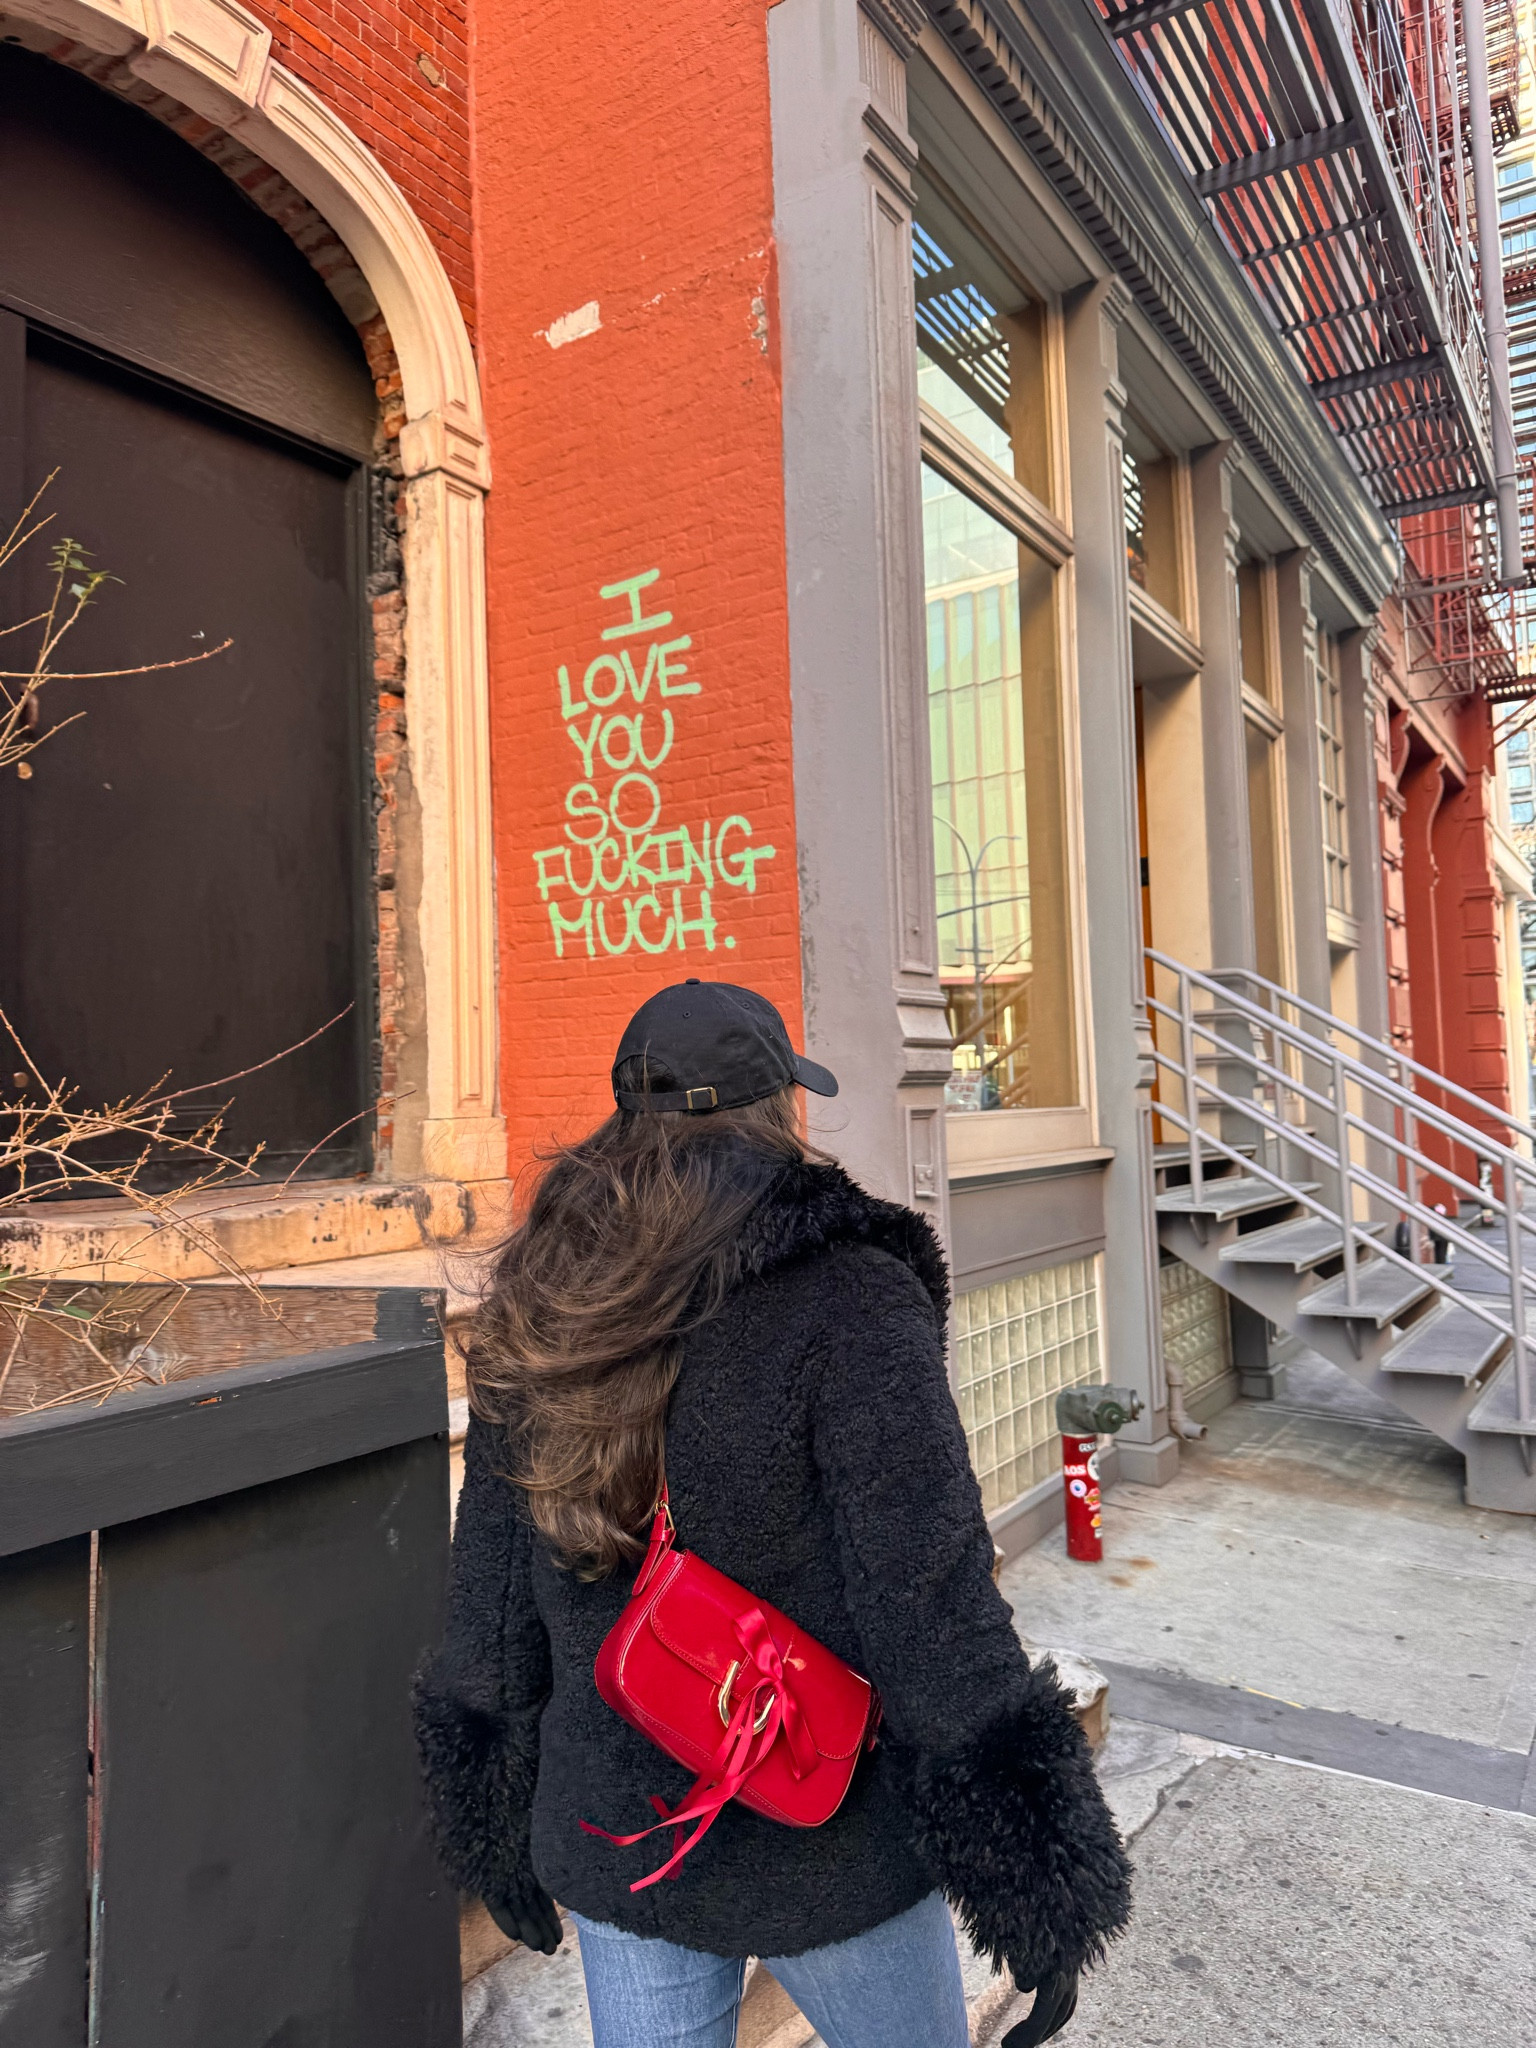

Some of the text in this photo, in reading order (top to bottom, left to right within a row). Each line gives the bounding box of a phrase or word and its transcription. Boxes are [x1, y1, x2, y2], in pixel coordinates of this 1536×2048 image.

[600, 568, 672, 640] I
[558, 635, 701, 720] LOVE
[567, 709, 674, 778] YOU
[564, 772, 661, 845] SO
[533, 815, 776, 900] FUCKING
[548, 889, 737, 957] MUCH.
